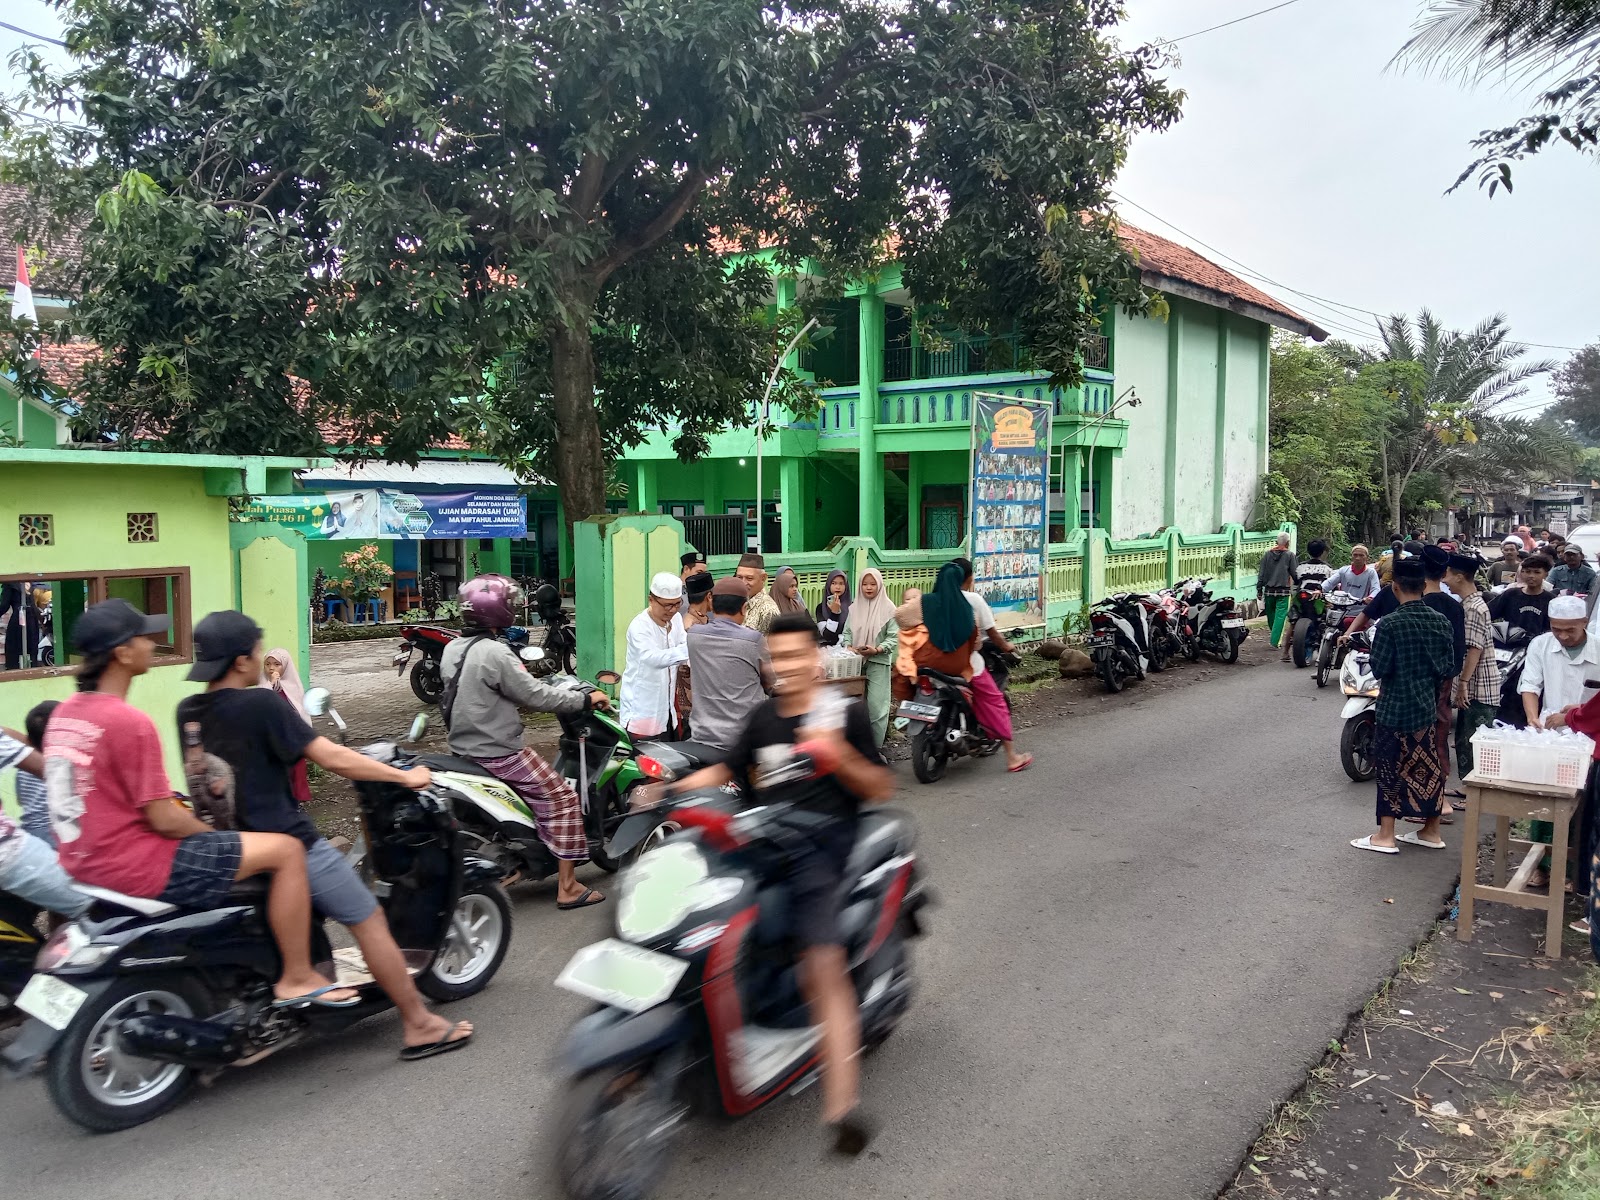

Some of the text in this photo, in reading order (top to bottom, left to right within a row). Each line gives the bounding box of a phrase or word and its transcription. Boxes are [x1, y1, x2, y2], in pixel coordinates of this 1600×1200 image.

[265, 505, 296, 513] Puasa
[503, 508, 520, 516] (UM)
[268, 514, 305, 522] 1446 H
